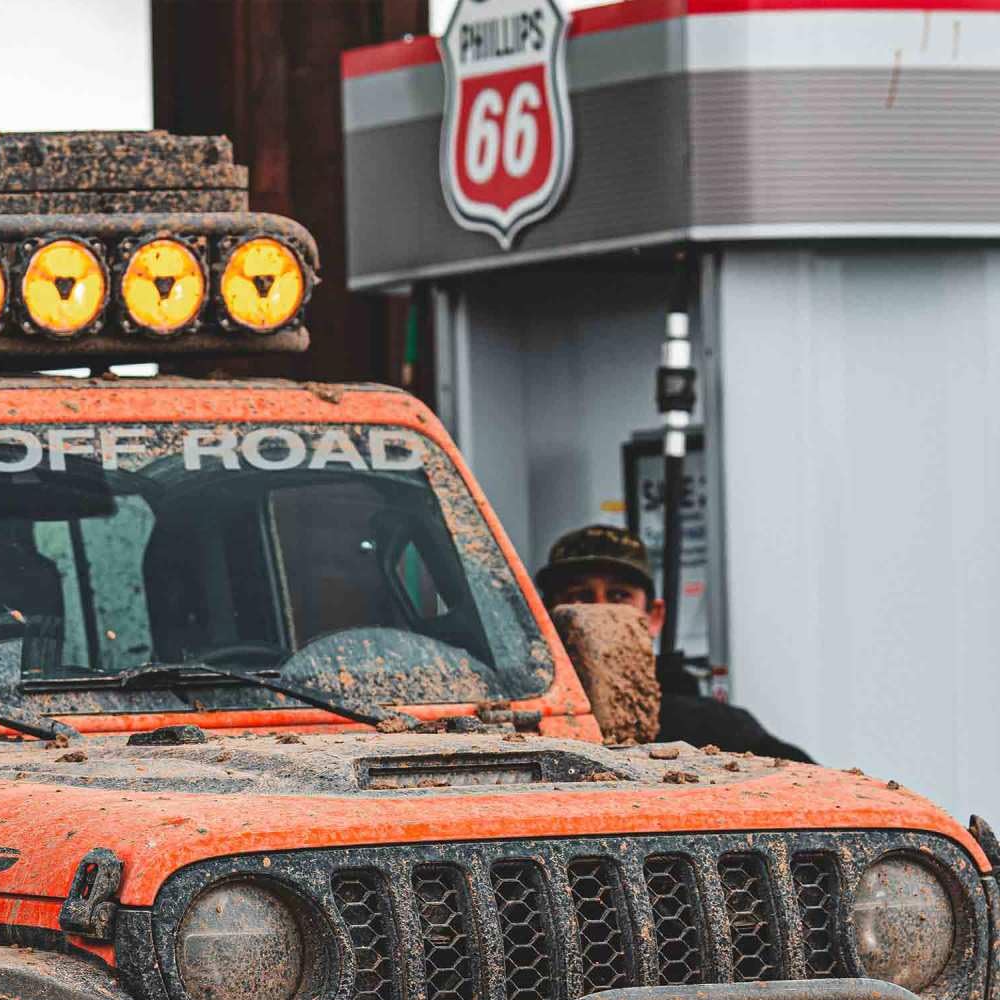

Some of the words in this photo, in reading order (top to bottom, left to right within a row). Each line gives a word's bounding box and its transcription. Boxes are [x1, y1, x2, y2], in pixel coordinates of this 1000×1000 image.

[459, 9, 545, 64] PHILLIPS
[465, 81, 541, 185] 66
[183, 427, 426, 472] ROAD
